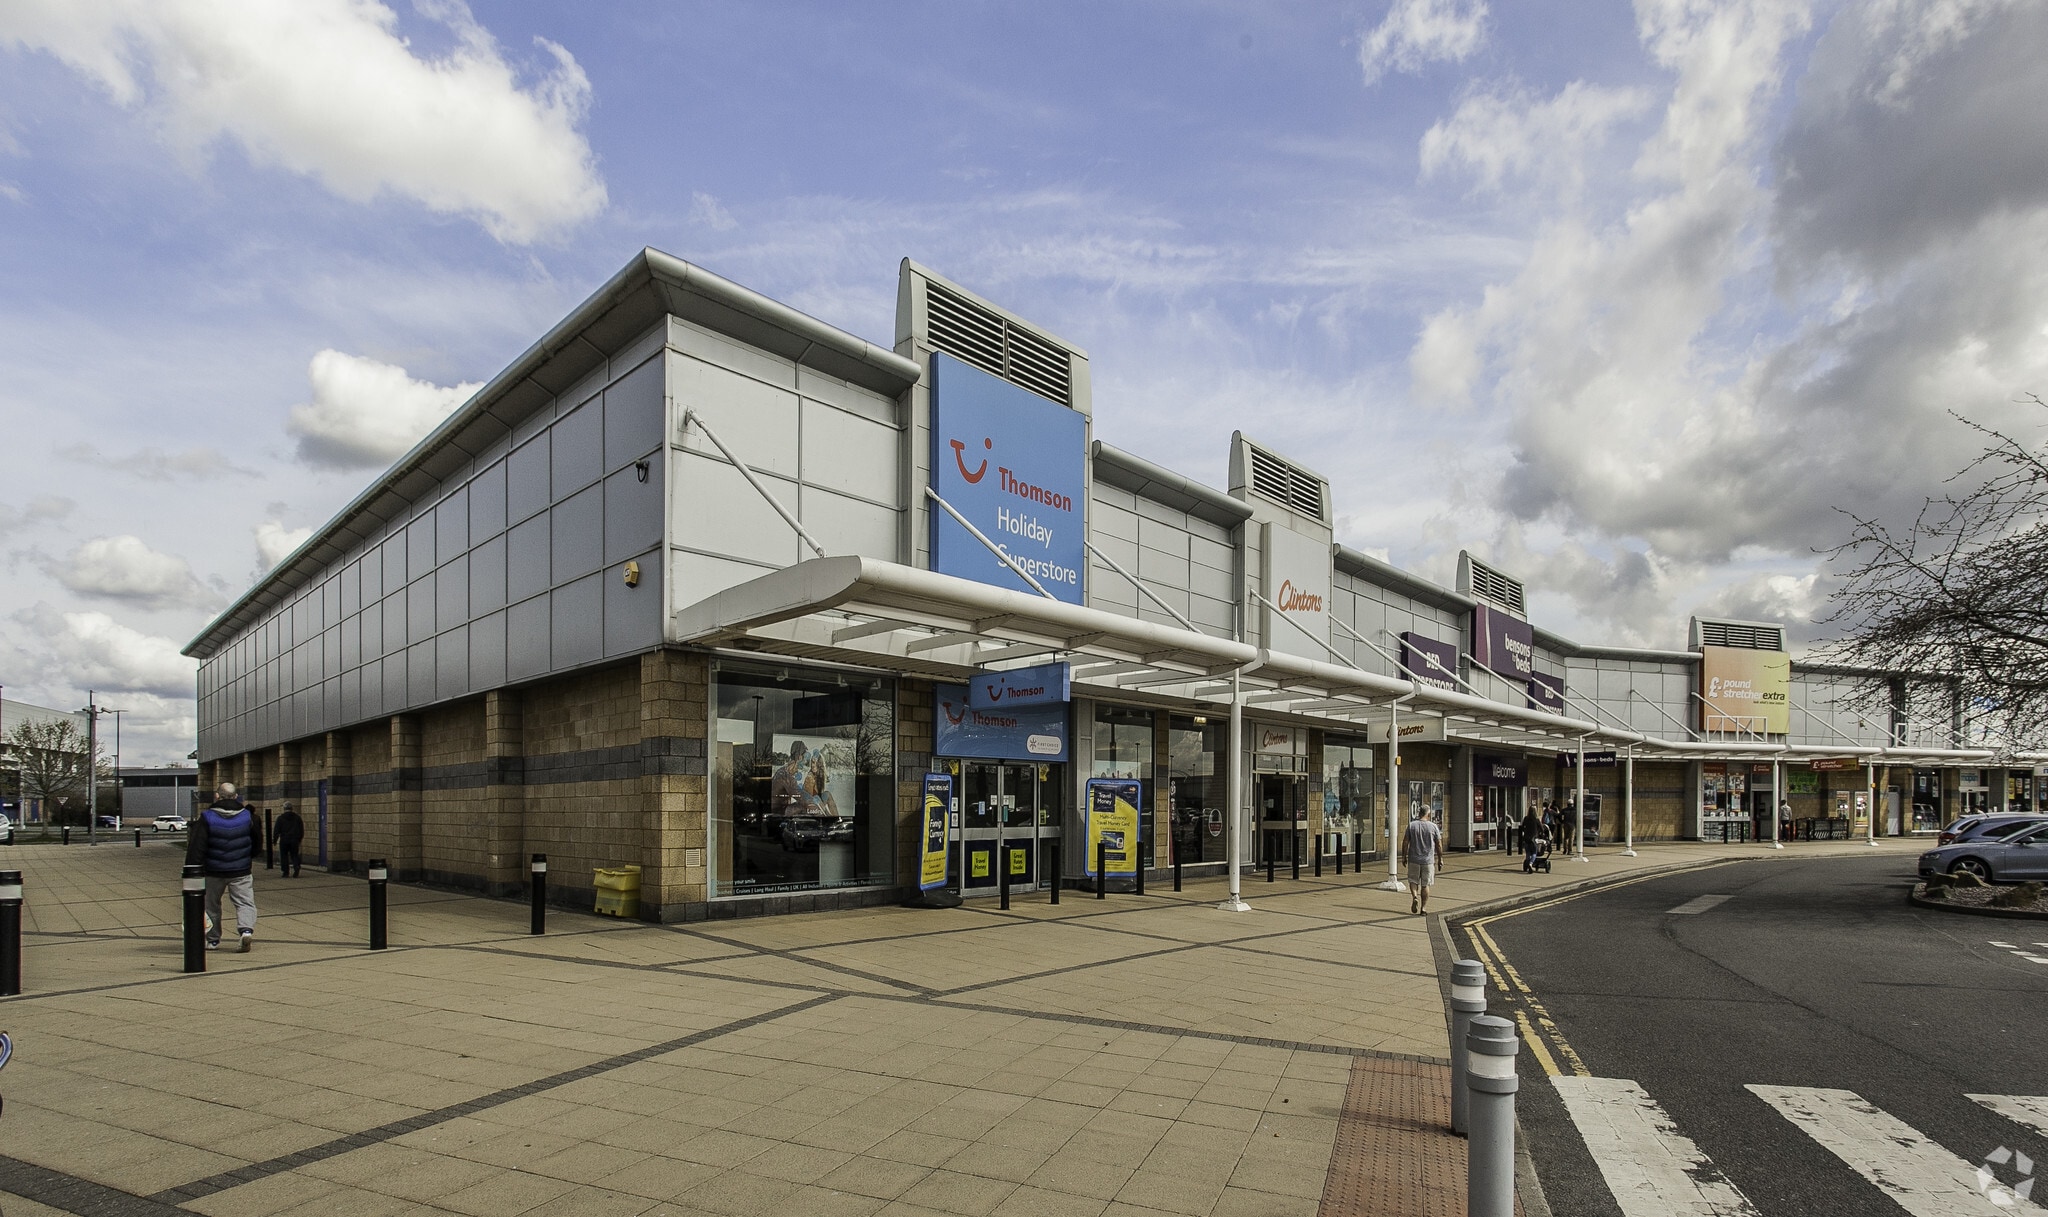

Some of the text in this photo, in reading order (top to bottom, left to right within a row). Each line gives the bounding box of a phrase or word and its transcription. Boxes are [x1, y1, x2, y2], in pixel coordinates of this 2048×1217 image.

[998, 466, 1072, 512] Thomson
[997, 506, 1053, 549] Holiday
[1278, 579, 1322, 612] Clintons
[1505, 632, 1531, 658] bensons
[1426, 651, 1440, 670] BED
[1516, 654, 1531, 674] beds
[1007, 686, 1044, 699] Thomson
[1723, 680, 1752, 690] pound
[1723, 689, 1786, 701] stretcher extra
[971, 711, 1018, 728] Thomson
[1262, 729, 1288, 748] Clintons
[1386, 724, 1425, 739] Cintons
[1491, 763, 1516, 779] Welcome
[1097, 798, 1113, 806] Money
